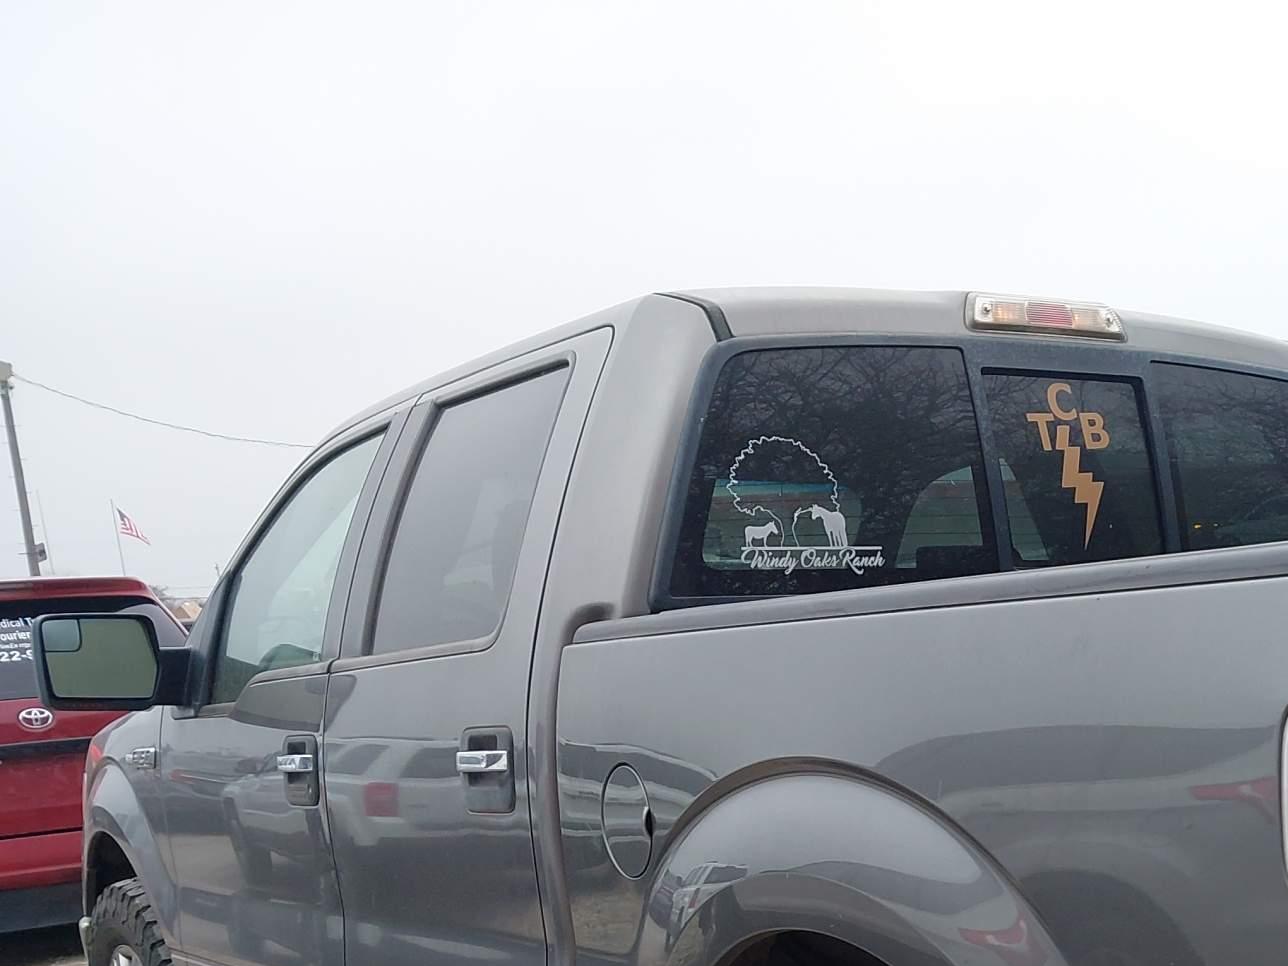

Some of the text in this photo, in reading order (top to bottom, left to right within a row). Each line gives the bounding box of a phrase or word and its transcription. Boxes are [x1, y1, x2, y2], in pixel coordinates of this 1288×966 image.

[741, 549, 885, 575] Windy Oaks Ranch
